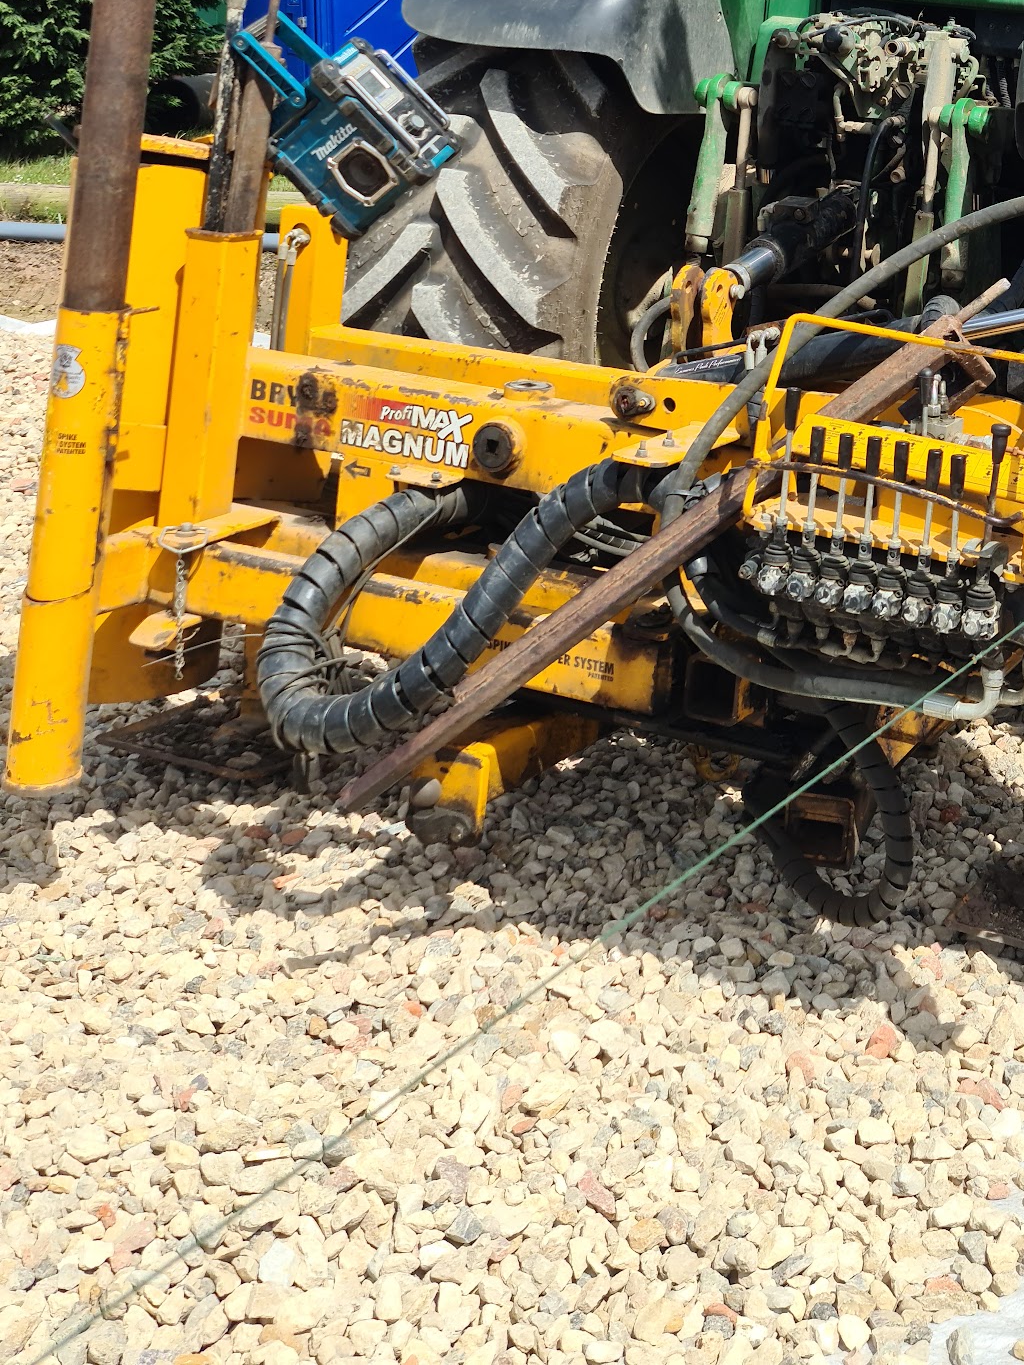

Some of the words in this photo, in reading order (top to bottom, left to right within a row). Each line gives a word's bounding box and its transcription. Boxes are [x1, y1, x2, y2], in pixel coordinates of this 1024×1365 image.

[57, 432, 78, 441] SPIKE
[59, 441, 86, 449] SYSTEM
[340, 419, 470, 468] MAGNUM
[486, 638, 513, 652] SPIK
[557, 654, 571, 666] ER
[573, 656, 615, 675] SYSTEM
[587, 672, 614, 682] PATENTED
